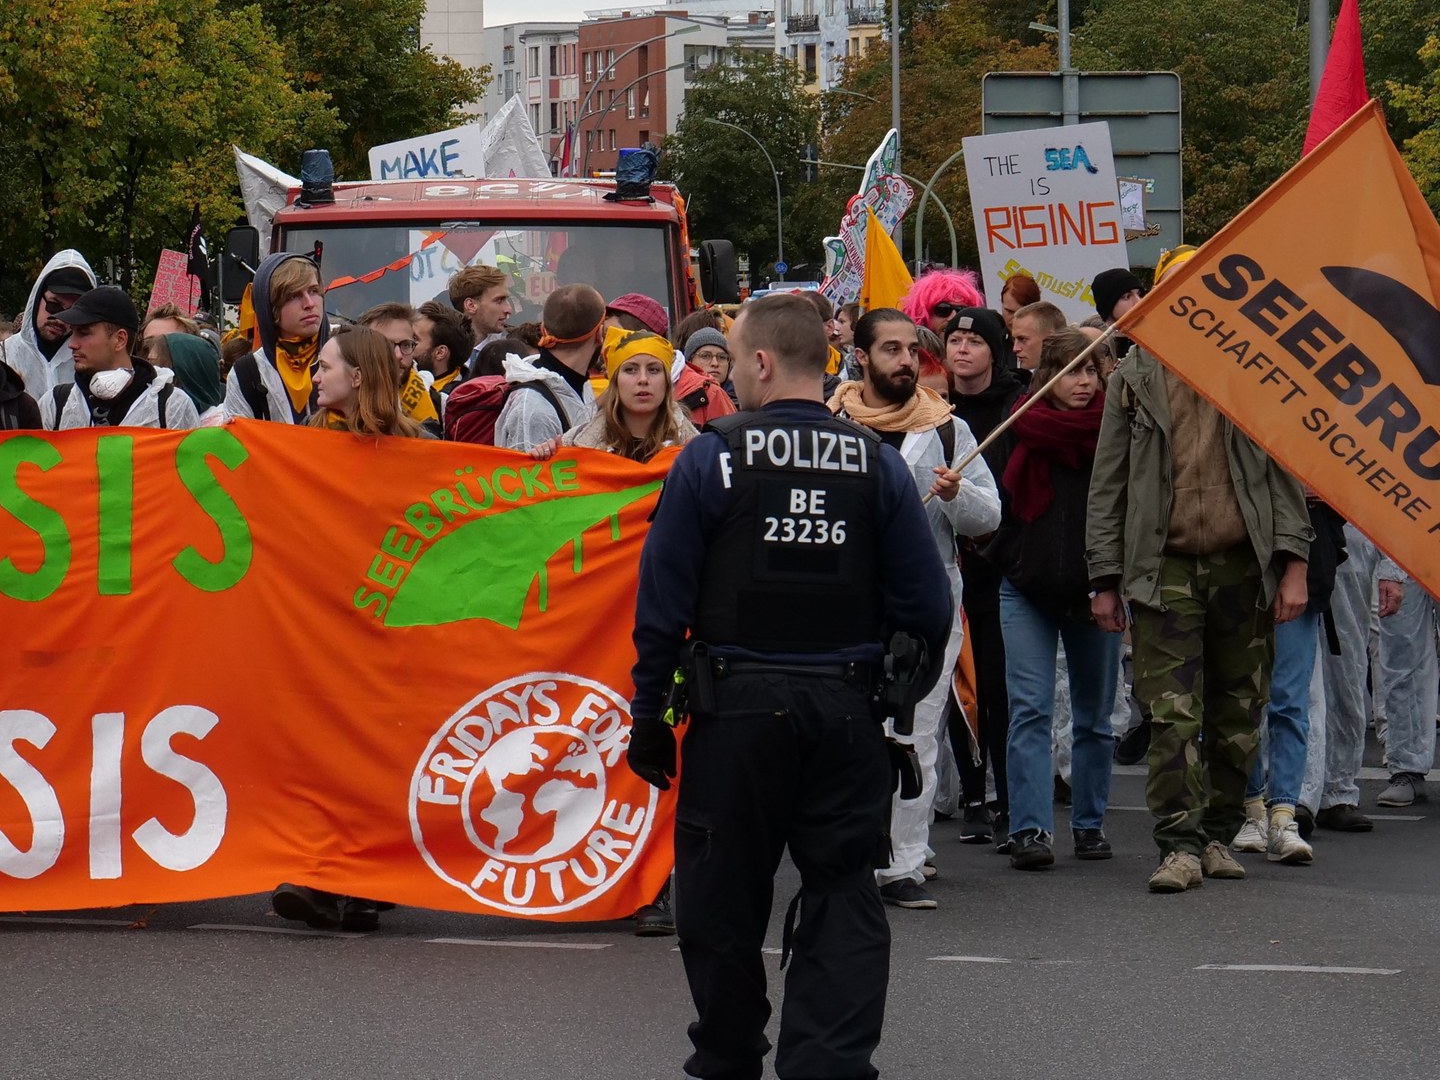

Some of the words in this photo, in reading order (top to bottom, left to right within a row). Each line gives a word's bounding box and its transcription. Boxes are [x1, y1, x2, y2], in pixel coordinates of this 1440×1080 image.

[379, 138, 460, 180] MAKE
[984, 154, 1021, 177] THE
[1044, 144, 1098, 174] SEA
[1030, 177, 1051, 196] IS
[983, 200, 1119, 253] RISING
[1169, 295, 1307, 404] SCHAFFT
[1302, 407, 1432, 521] SICHERE
[745, 428, 868, 473] POLIZEI
[789, 488, 826, 515] BE
[353, 459, 580, 617] SEEBRÜCKE
[763, 516, 847, 545] 23236
[418, 681, 561, 805] FRIDAYS
[570, 692, 633, 768] FOR
[471, 799, 645, 905] FUTURE
